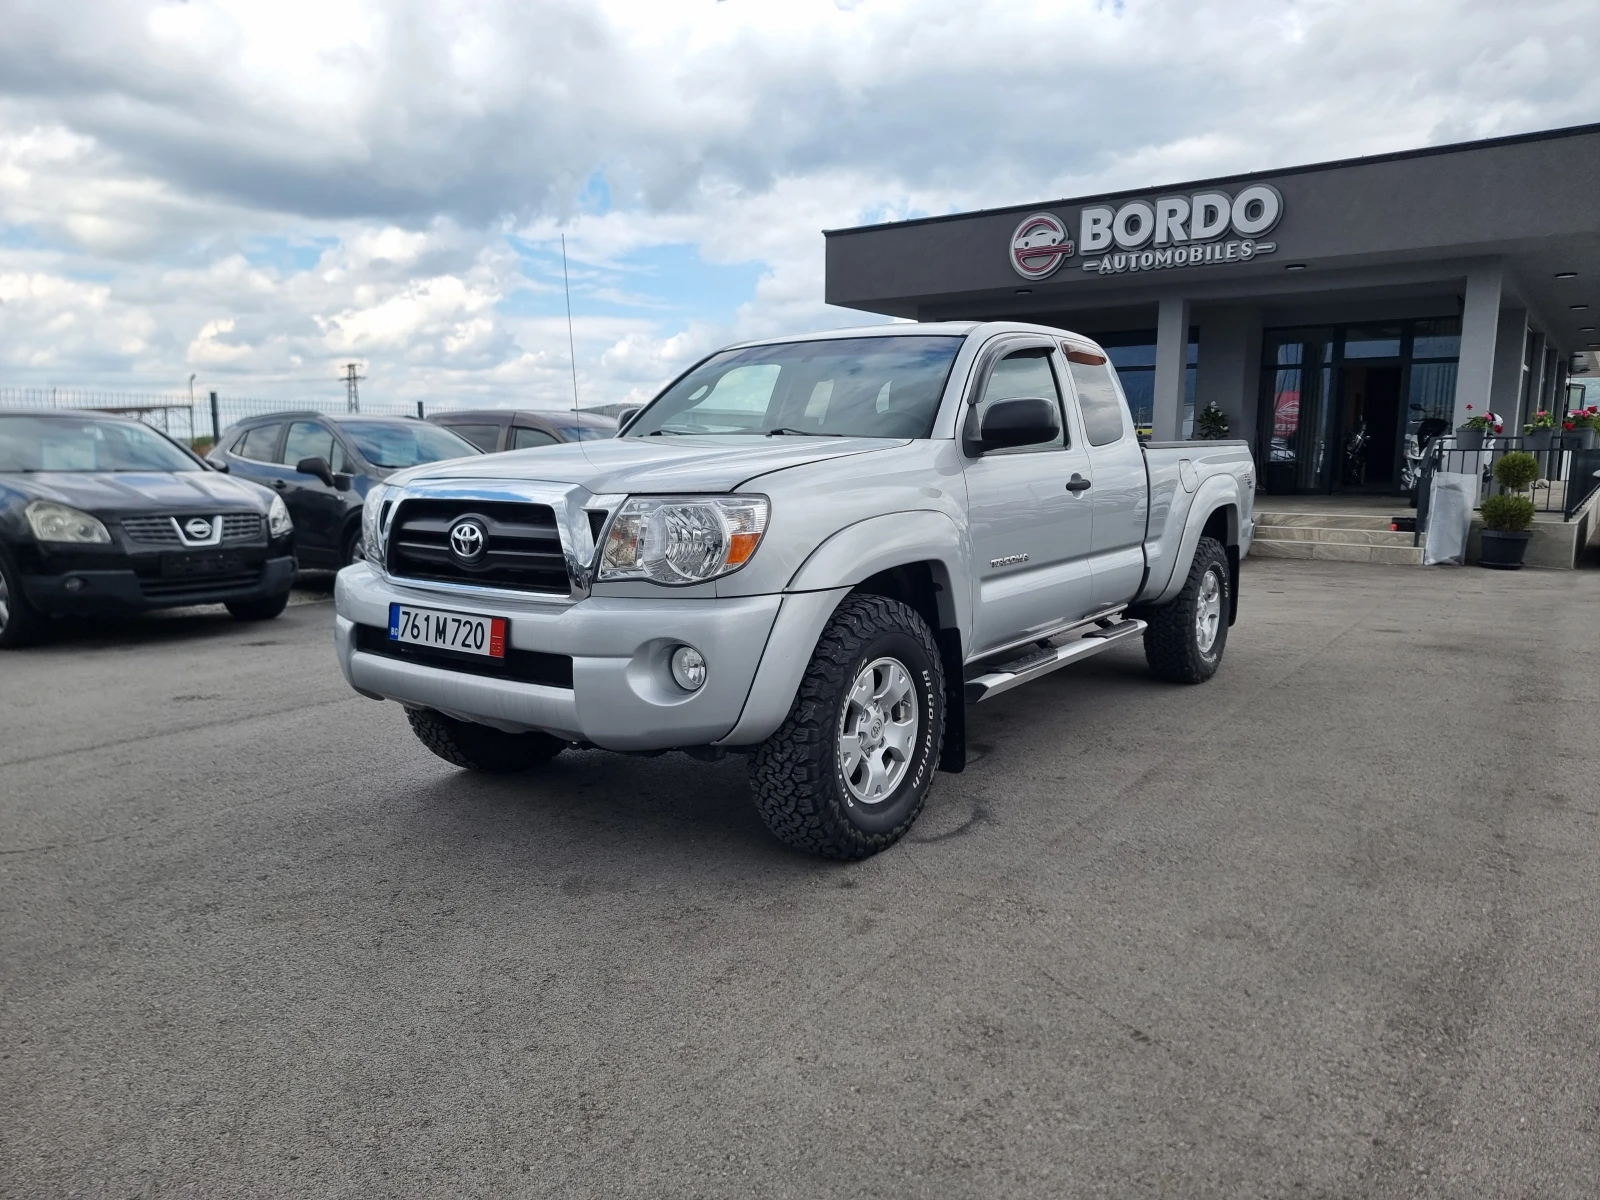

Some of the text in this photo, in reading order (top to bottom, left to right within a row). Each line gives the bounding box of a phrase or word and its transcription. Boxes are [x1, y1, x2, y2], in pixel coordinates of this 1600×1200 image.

[1080, 186, 1280, 252] BORDO
[1100, 241, 1253, 271] AUTOMOBILES
[390, 626, 399, 636] BG
